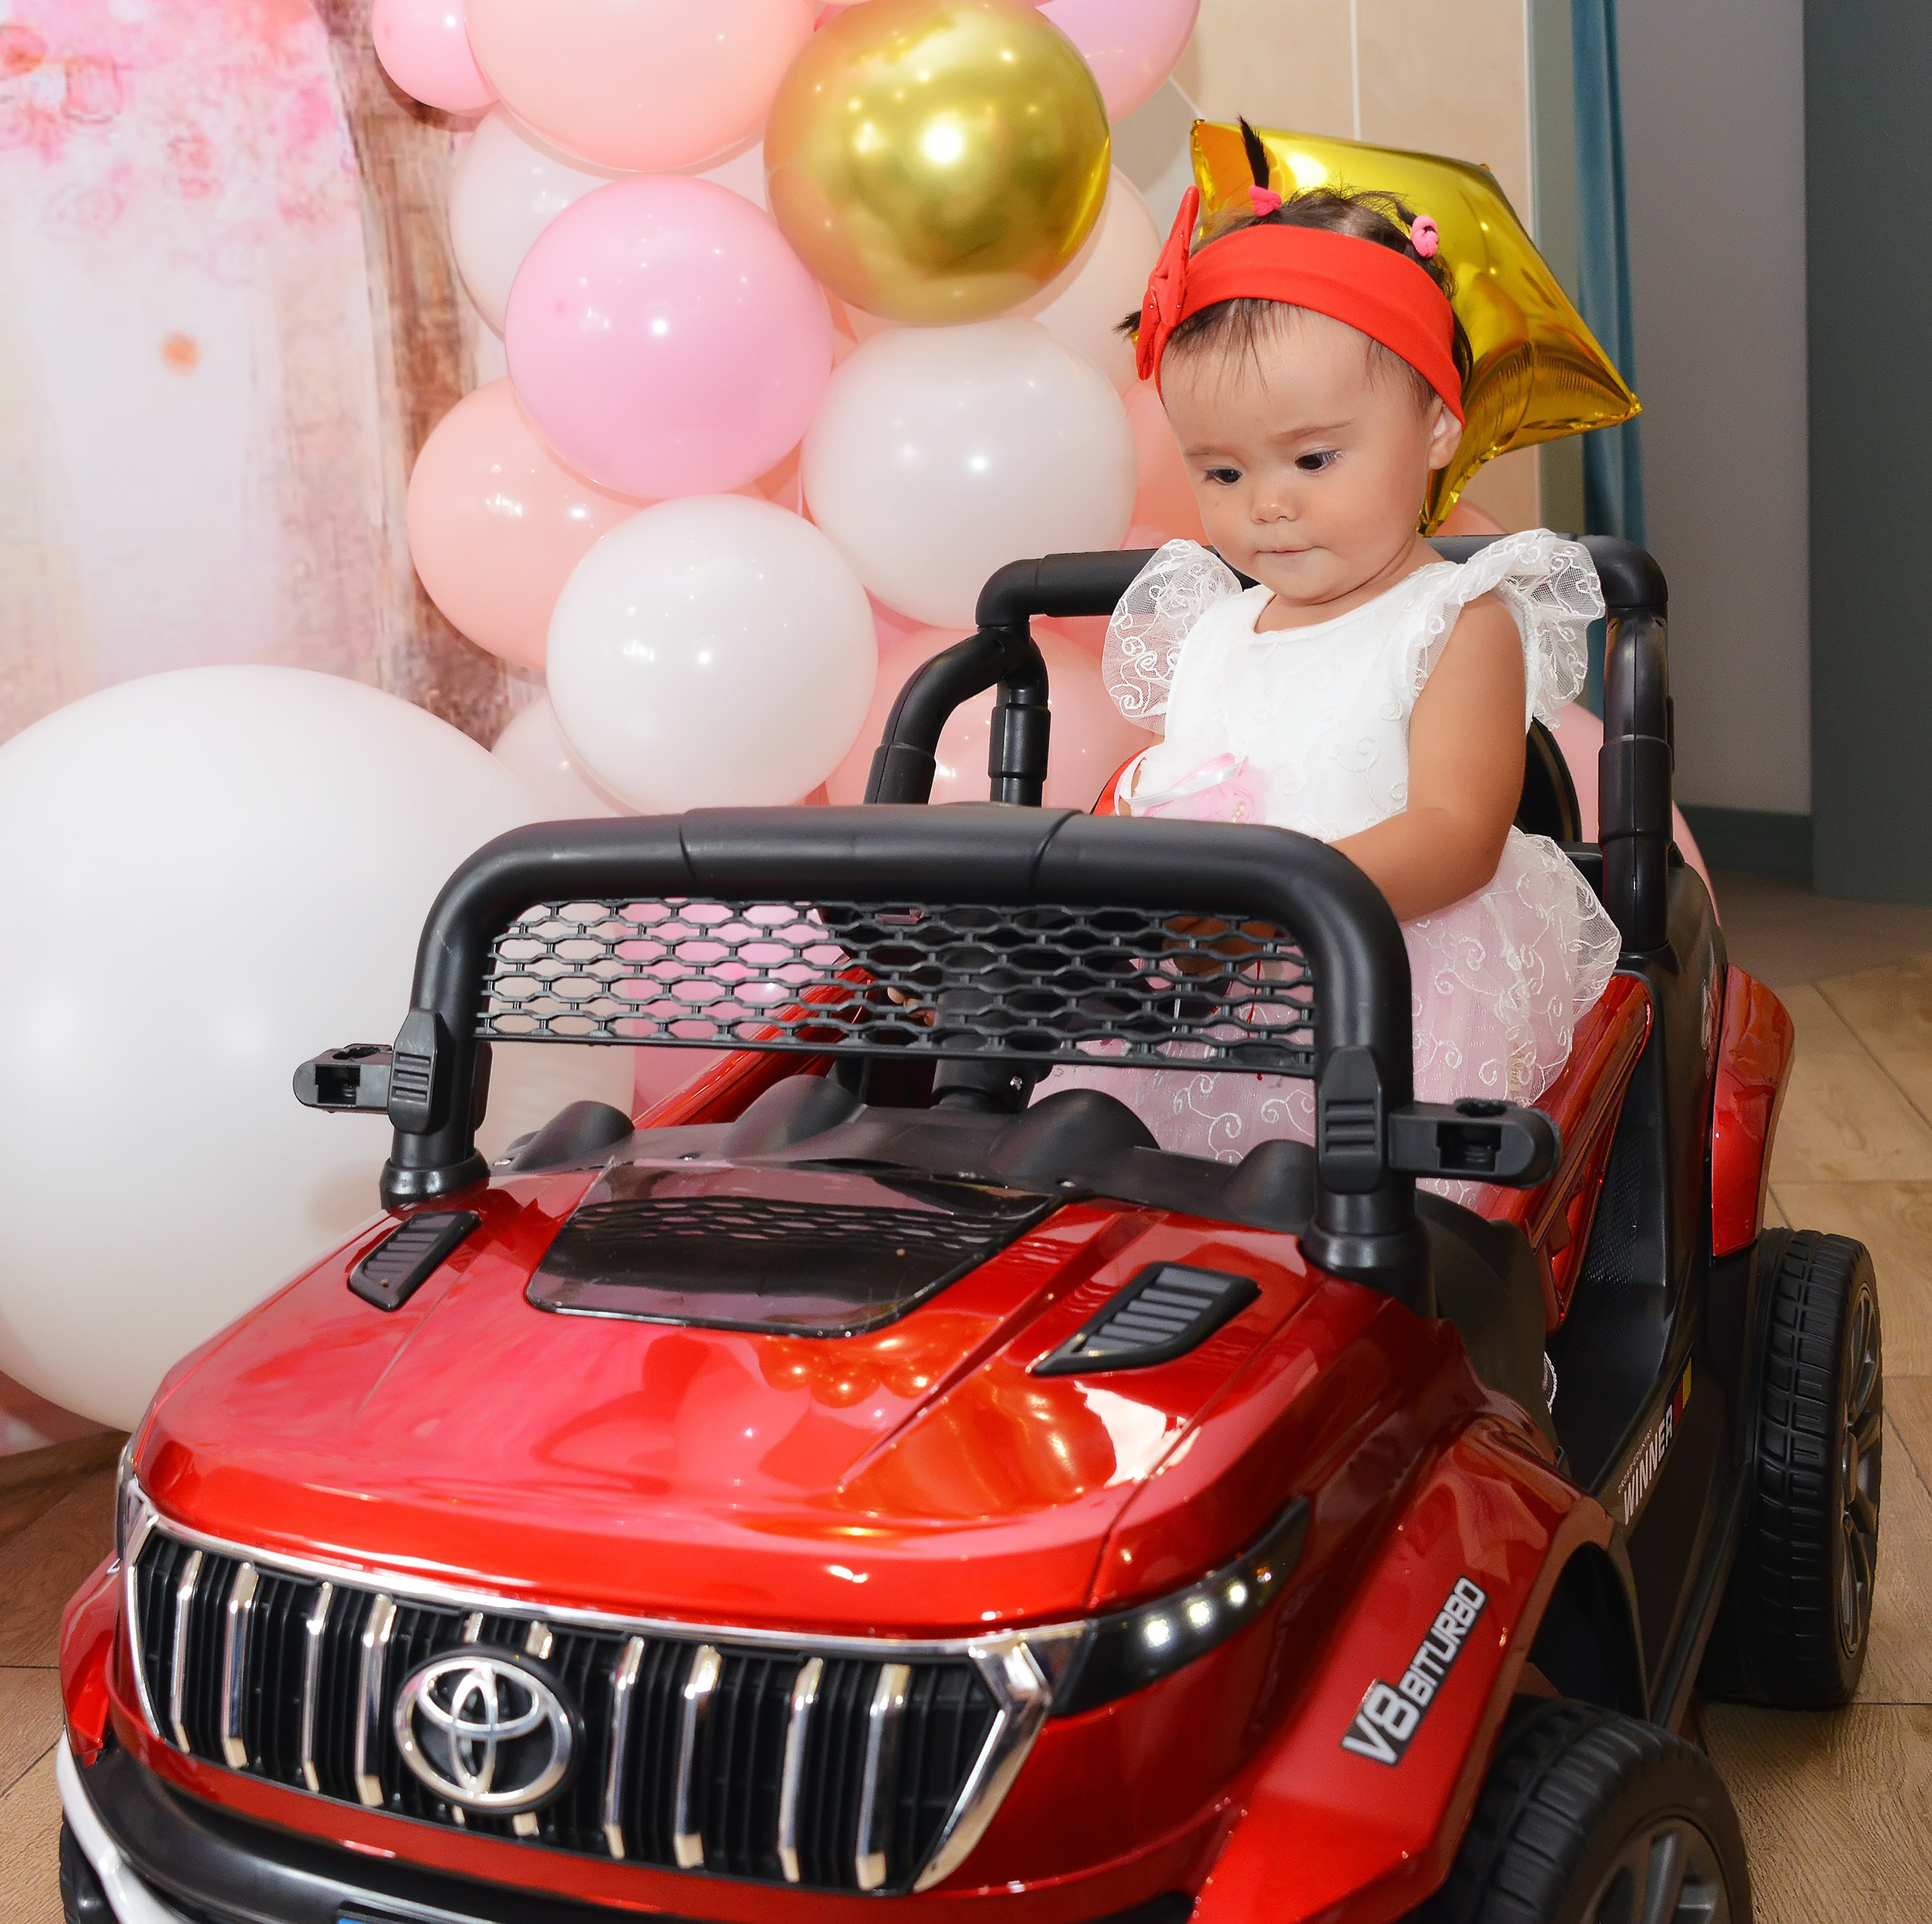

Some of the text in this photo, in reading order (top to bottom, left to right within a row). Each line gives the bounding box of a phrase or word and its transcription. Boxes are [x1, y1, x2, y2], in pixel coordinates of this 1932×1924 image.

[1624, 1404, 1673, 1526] WINNER
[1342, 1578, 1486, 1764] V8 BITURBO
